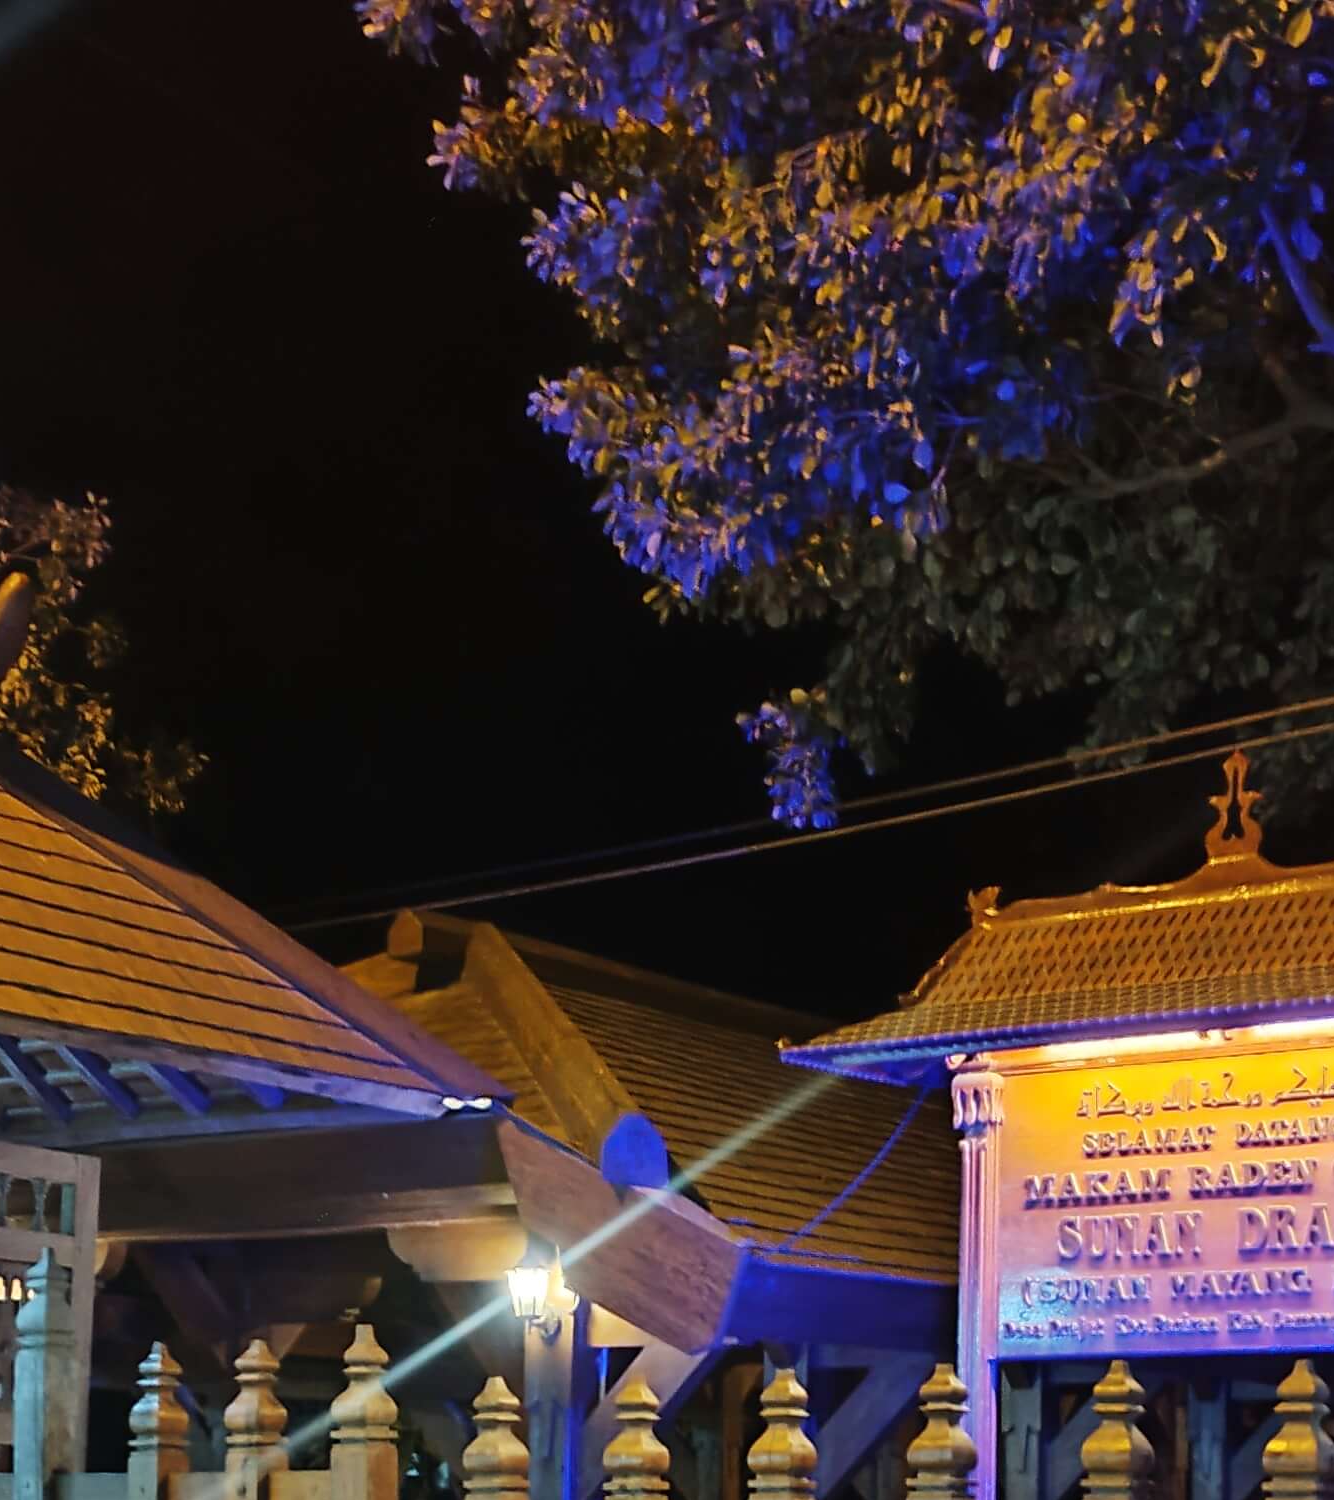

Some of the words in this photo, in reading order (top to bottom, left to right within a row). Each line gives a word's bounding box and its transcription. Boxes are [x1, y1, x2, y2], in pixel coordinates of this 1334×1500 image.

[1082, 1126, 1216, 1158] SELAMAT
[1024, 1167, 1172, 1209] MAKAM
[1187, 1158, 1318, 1199] RADEN
[1056, 1210, 1204, 1264] SUNAN
[1022, 1274, 1152, 1308] (SUNAN
[1170, 1268, 1312, 1300] MAYANG
